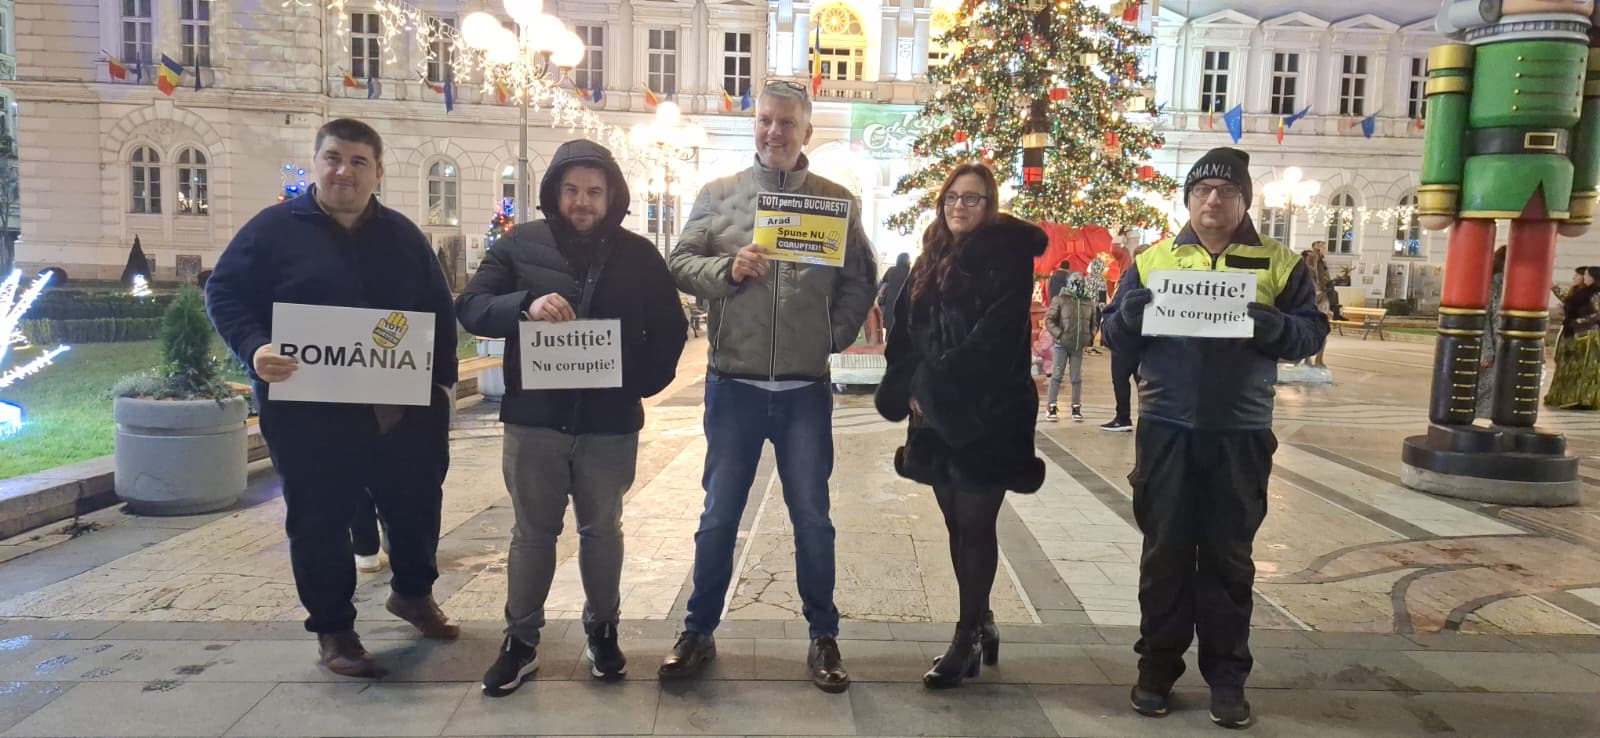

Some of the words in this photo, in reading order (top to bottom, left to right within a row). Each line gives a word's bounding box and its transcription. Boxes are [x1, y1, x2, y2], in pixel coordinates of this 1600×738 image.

[779, 197, 803, 210] pentru
[803, 198, 848, 216] BUCUREȘTI
[767, 217, 791, 226] Arad
[777, 227, 808, 239] Spune
[810, 230, 825, 240] NU
[1157, 279, 1247, 301] Justiție!
[1155, 305, 1175, 318] Nu
[1180, 311, 1246, 324] corupție!
[531, 329, 612, 350] Justiție!
[279, 342, 417, 370] ROMÂNIA
[532, 359, 552, 372] Nu
[556, 359, 616, 373] corupție!
